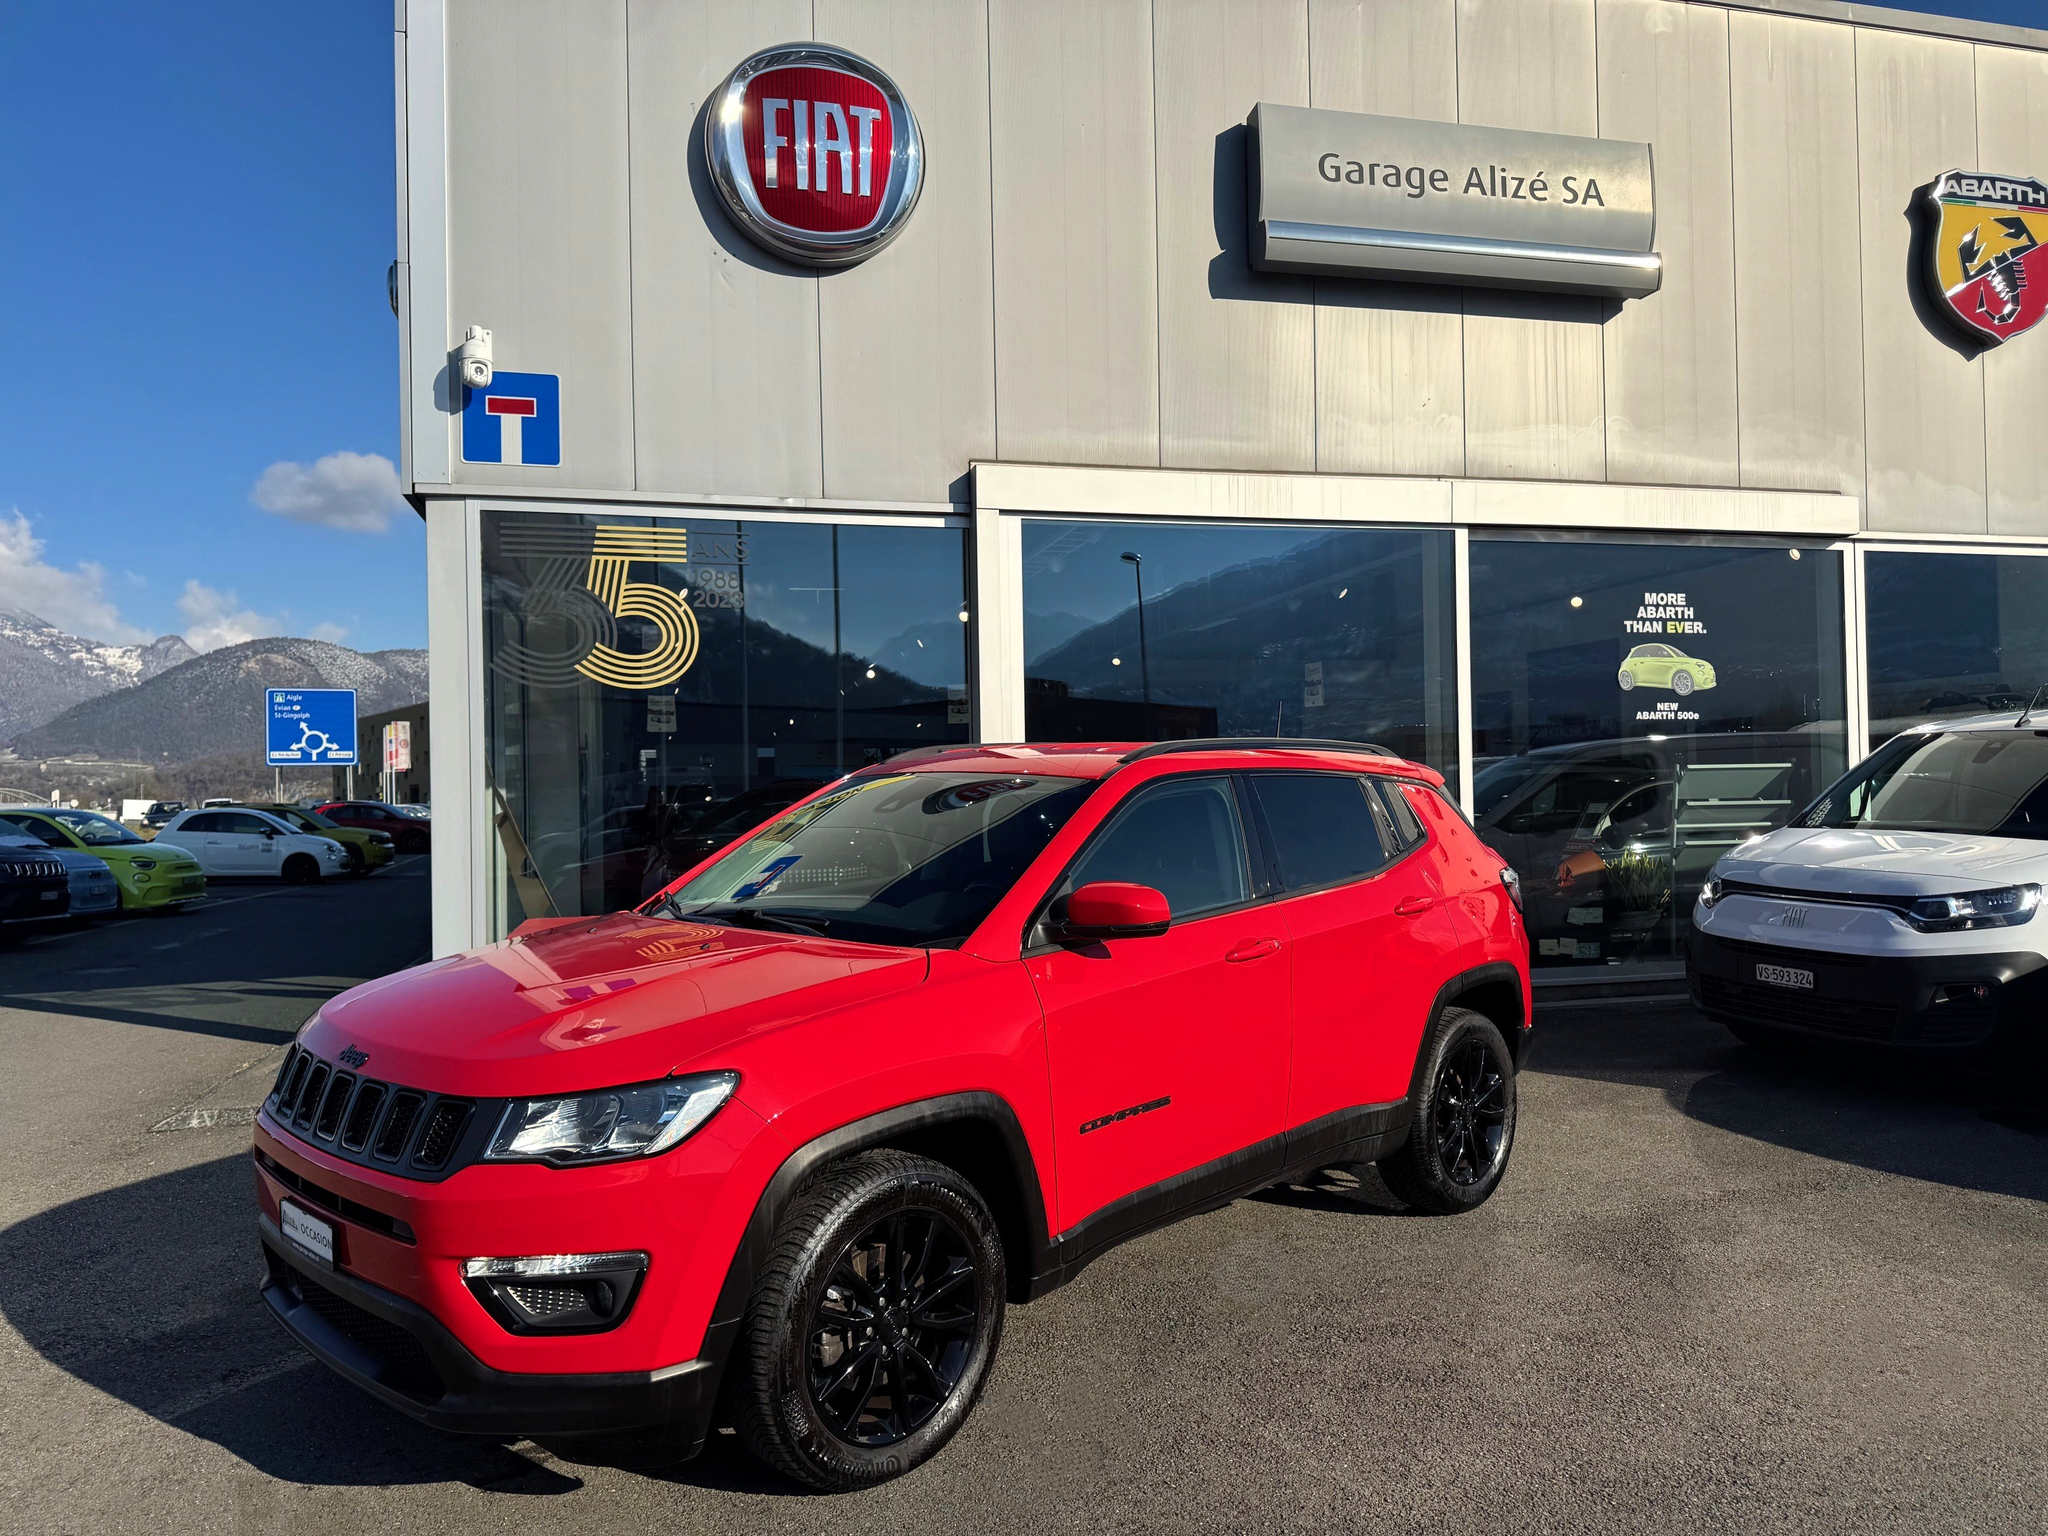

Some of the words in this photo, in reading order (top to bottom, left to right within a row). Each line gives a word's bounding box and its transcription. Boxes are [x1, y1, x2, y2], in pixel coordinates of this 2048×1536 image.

[762, 98, 881, 197] FIAT
[1317, 152, 1450, 199] Garage
[1462, 164, 1549, 202] Alizé
[1561, 176, 1605, 207] SA
[1943, 179, 2045, 205] ABARTH
[691, 540, 749, 559] ANS
[692, 569, 740, 589] 1988
[488, 521, 700, 690] 35
[693, 589, 745, 609] 2023
[1644, 592, 1686, 606] MORE
[1637, 606, 1694, 619] ABARTH
[1624, 620, 1662, 633] THAN
[1666, 621, 1707, 634] EVER.
[286, 694, 302, 702] Aigle
[1656, 702, 1679, 711] NEW
[274, 711, 311, 720] St-Gingolph
[1636, 711, 1675, 720] ABARTH
[1677, 711, 1700, 720] 500e
[1782, 906, 1809, 929] FIAT
[339, 1044, 370, 1069] Jeep
[1080, 1095, 1171, 1134] COMPASS
[300, 1223, 333, 1250] OCCASION
